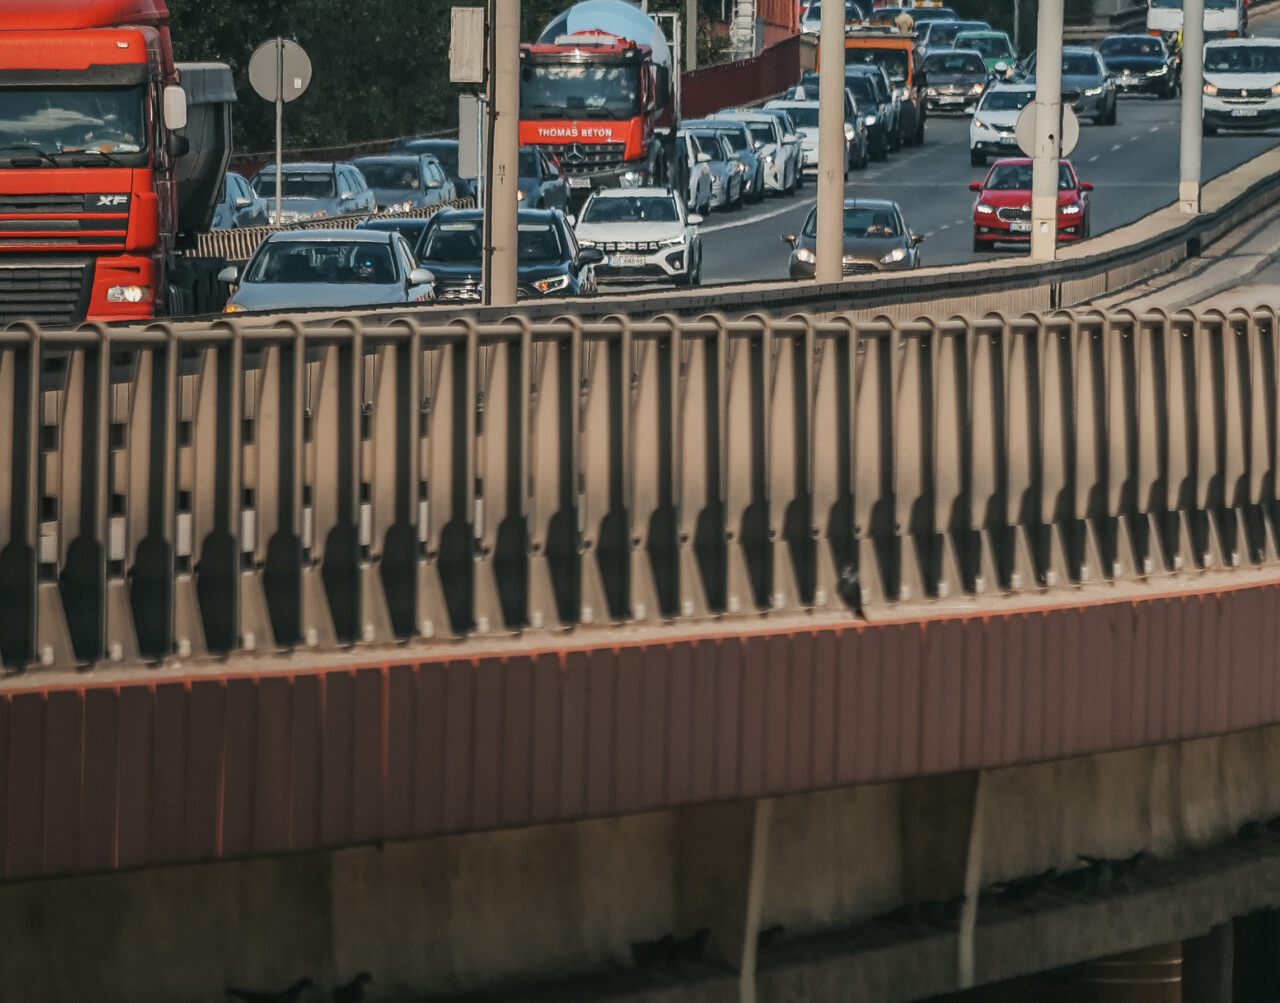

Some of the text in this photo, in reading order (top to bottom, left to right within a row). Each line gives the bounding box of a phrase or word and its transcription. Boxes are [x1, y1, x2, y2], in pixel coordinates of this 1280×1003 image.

[538, 128, 612, 137] THOMAS BETON
[96, 195, 128, 206] XF
